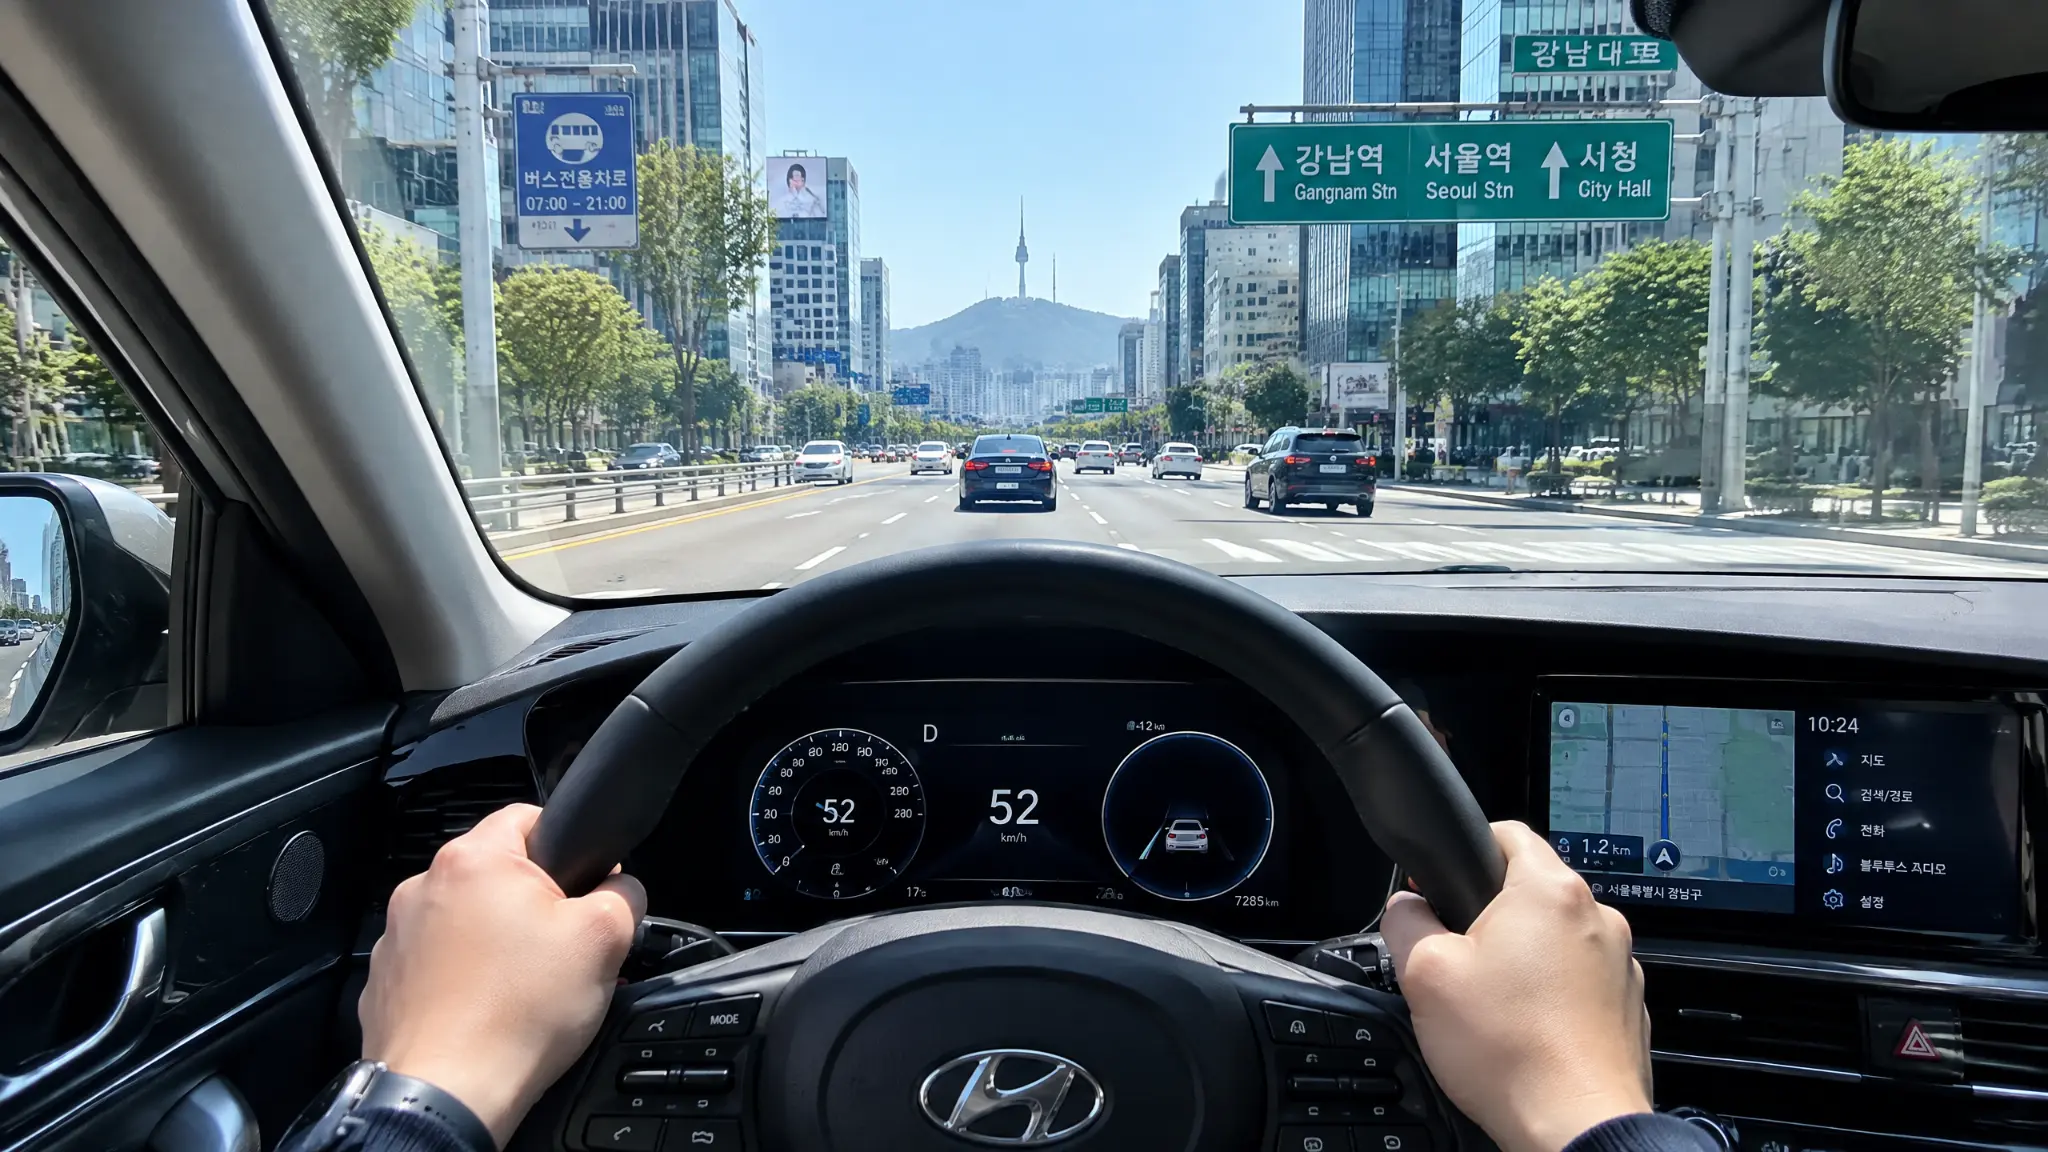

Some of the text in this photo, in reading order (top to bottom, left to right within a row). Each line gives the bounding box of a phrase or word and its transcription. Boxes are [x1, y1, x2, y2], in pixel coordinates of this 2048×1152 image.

[1295, 143, 1383, 176] 강남역
[1424, 142, 1512, 175] 서울역
[1294, 182, 1398, 204] Gangnam Stn
[1426, 180, 1515, 200] Seoul Stn
[1618, 179, 1652, 198] Hall
[526, 196, 568, 211] 07:00
[586, 195, 628, 211] 21:00
[923, 723, 939, 743] D
[1808, 716, 1860, 734] 10:24
[1860, 754, 1886, 768] 지도
[1860, 788, 1913, 803] 검색/경로
[822, 798, 856, 824] 52
[989, 788, 1039, 825] 52
[828, 828, 849, 838] km/h
[1000, 832, 1027, 843] km/h
[1860, 824, 1886, 838] 전화
[1582, 838, 1631, 856] 1.2 km
[1234, 895, 1280, 907] 7285 km
[710, 1013, 740, 1026] MODE
